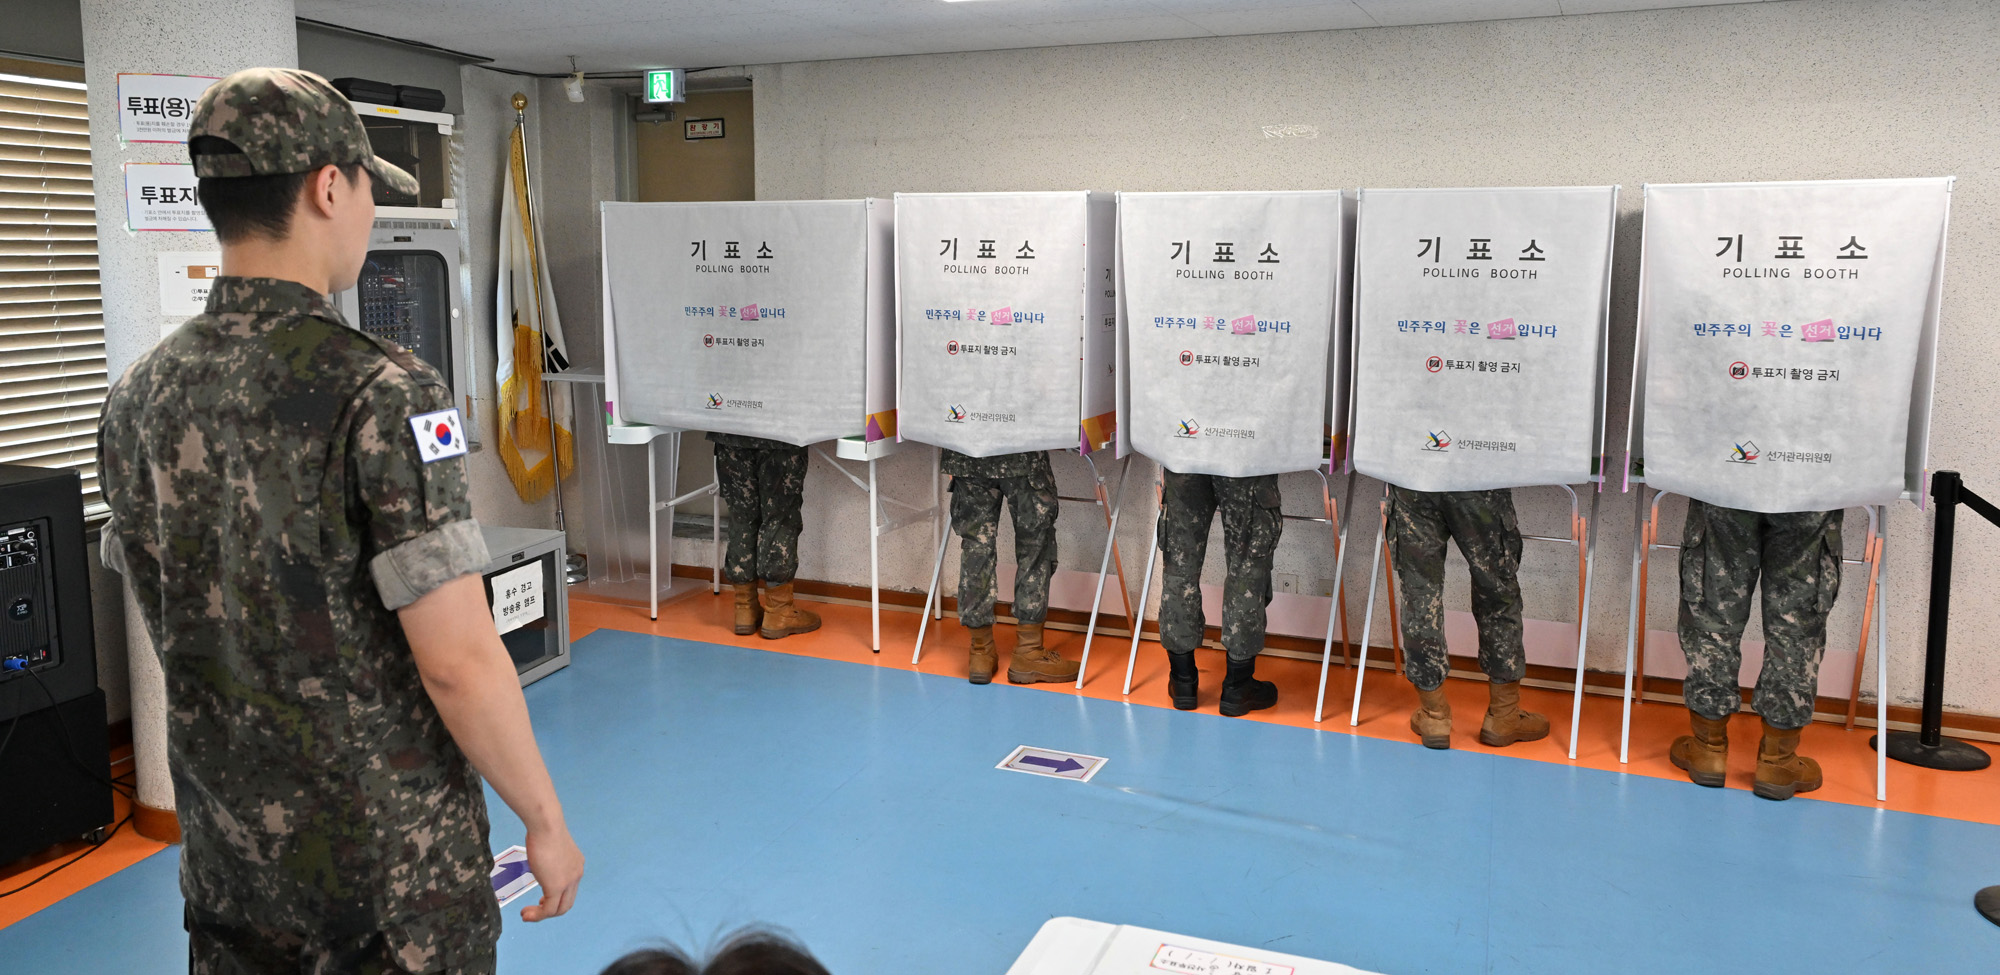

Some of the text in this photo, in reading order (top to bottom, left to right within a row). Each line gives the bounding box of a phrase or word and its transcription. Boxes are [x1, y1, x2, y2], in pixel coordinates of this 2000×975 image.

[140, 186, 198, 206] 투표지
[696, 265, 770, 274] POLLING BOOTH
[944, 265, 1029, 275] POLLING BOOTH
[1176, 269, 1274, 281] POLLING BOOTH
[1423, 267, 1538, 280] POLLING BOOTH
[1723, 267, 1859, 280] POLLING BOOTH
[684, 306, 715, 317] 민주주의
[718, 305, 737, 318] 꽃은
[925, 309, 961, 321] 민주주의
[966, 308, 987, 322] 꽃은
[1154, 316, 1197, 330] 민주주의
[1203, 316, 1227, 331] 꽃은
[1397, 319, 1447, 334] 민주주의
[1453, 319, 1480, 335] 꽃은
[1693, 322, 1752, 338] 민주주의
[1761, 320, 1794, 338] 꽃은
[715, 337, 765, 347] 투표지 촬영 금지
[960, 344, 1017, 356] 투표지 촬영 금지
[1195, 354, 1260, 368] 투표지 촬영 금지
[1445, 359, 1521, 374] 투표지 촬영 금지
[1751, 367, 1840, 381] 투표지 촬영 금지
[726, 399, 763, 409] 선거관리위원회
[969, 412, 1016, 422] 선거관리위원회
[1204, 426, 1255, 440] 선거관리위원회
[1457, 438, 1517, 452] 선거관리위원회
[1766, 450, 1833, 464] 선거관리위원회
[521, 581, 533, 593] 경고
[503, 601, 521, 617] 방송용
[524, 595, 536, 607] 앰프
